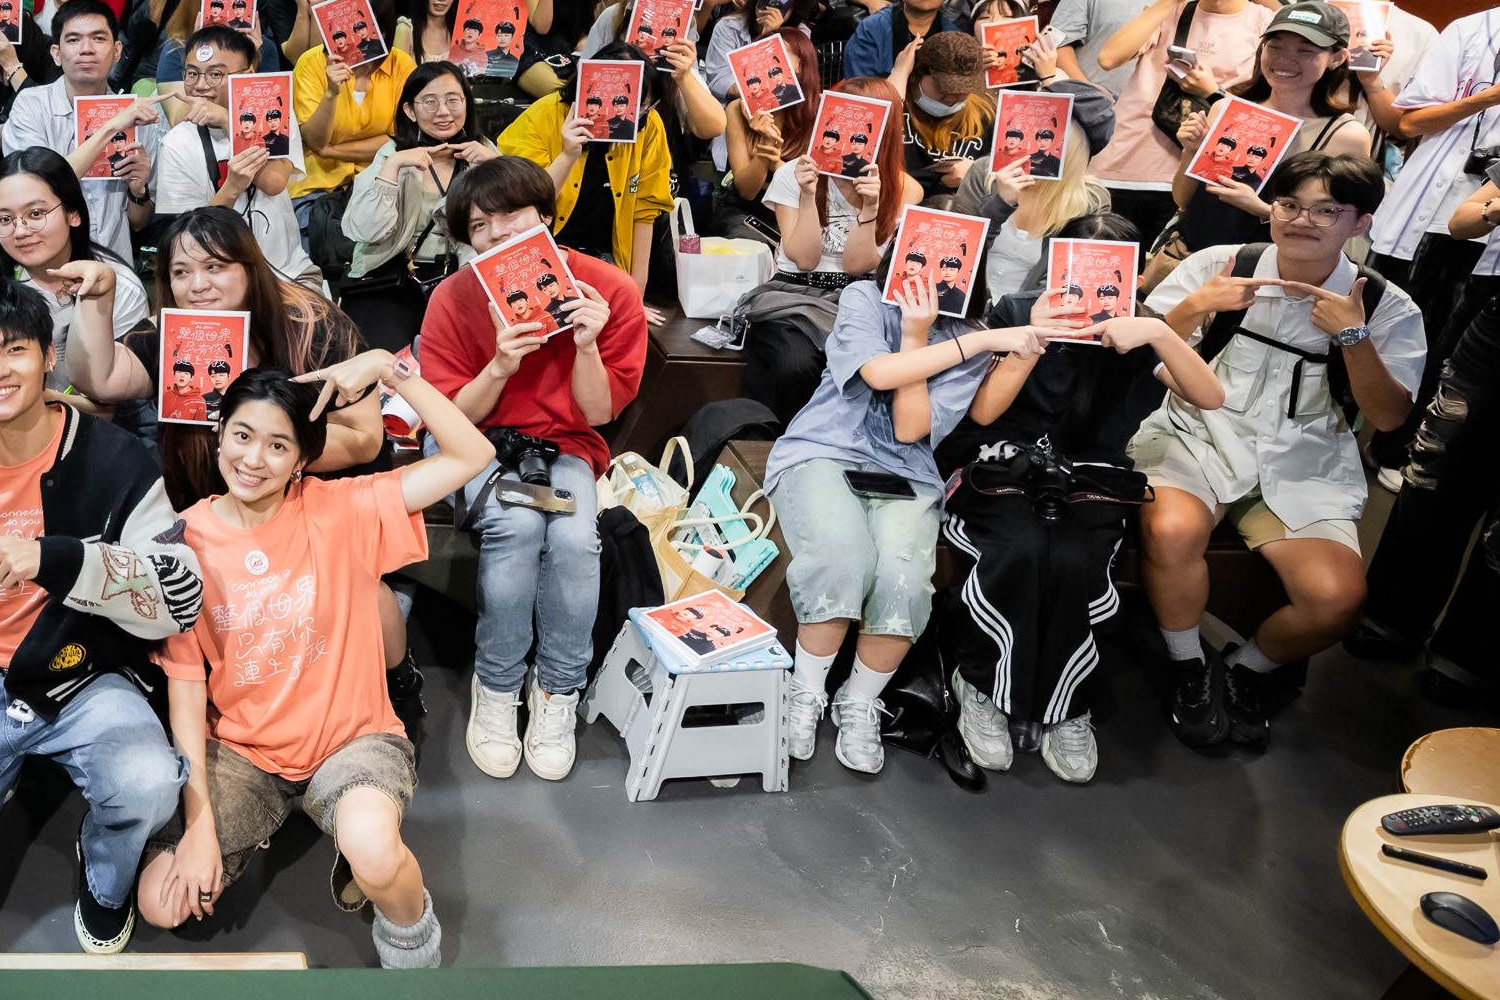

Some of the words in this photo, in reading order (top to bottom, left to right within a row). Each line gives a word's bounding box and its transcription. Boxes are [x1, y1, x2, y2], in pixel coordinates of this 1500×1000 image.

[211, 575, 317, 633] 整個世界
[236, 615, 317, 659] 只有你
